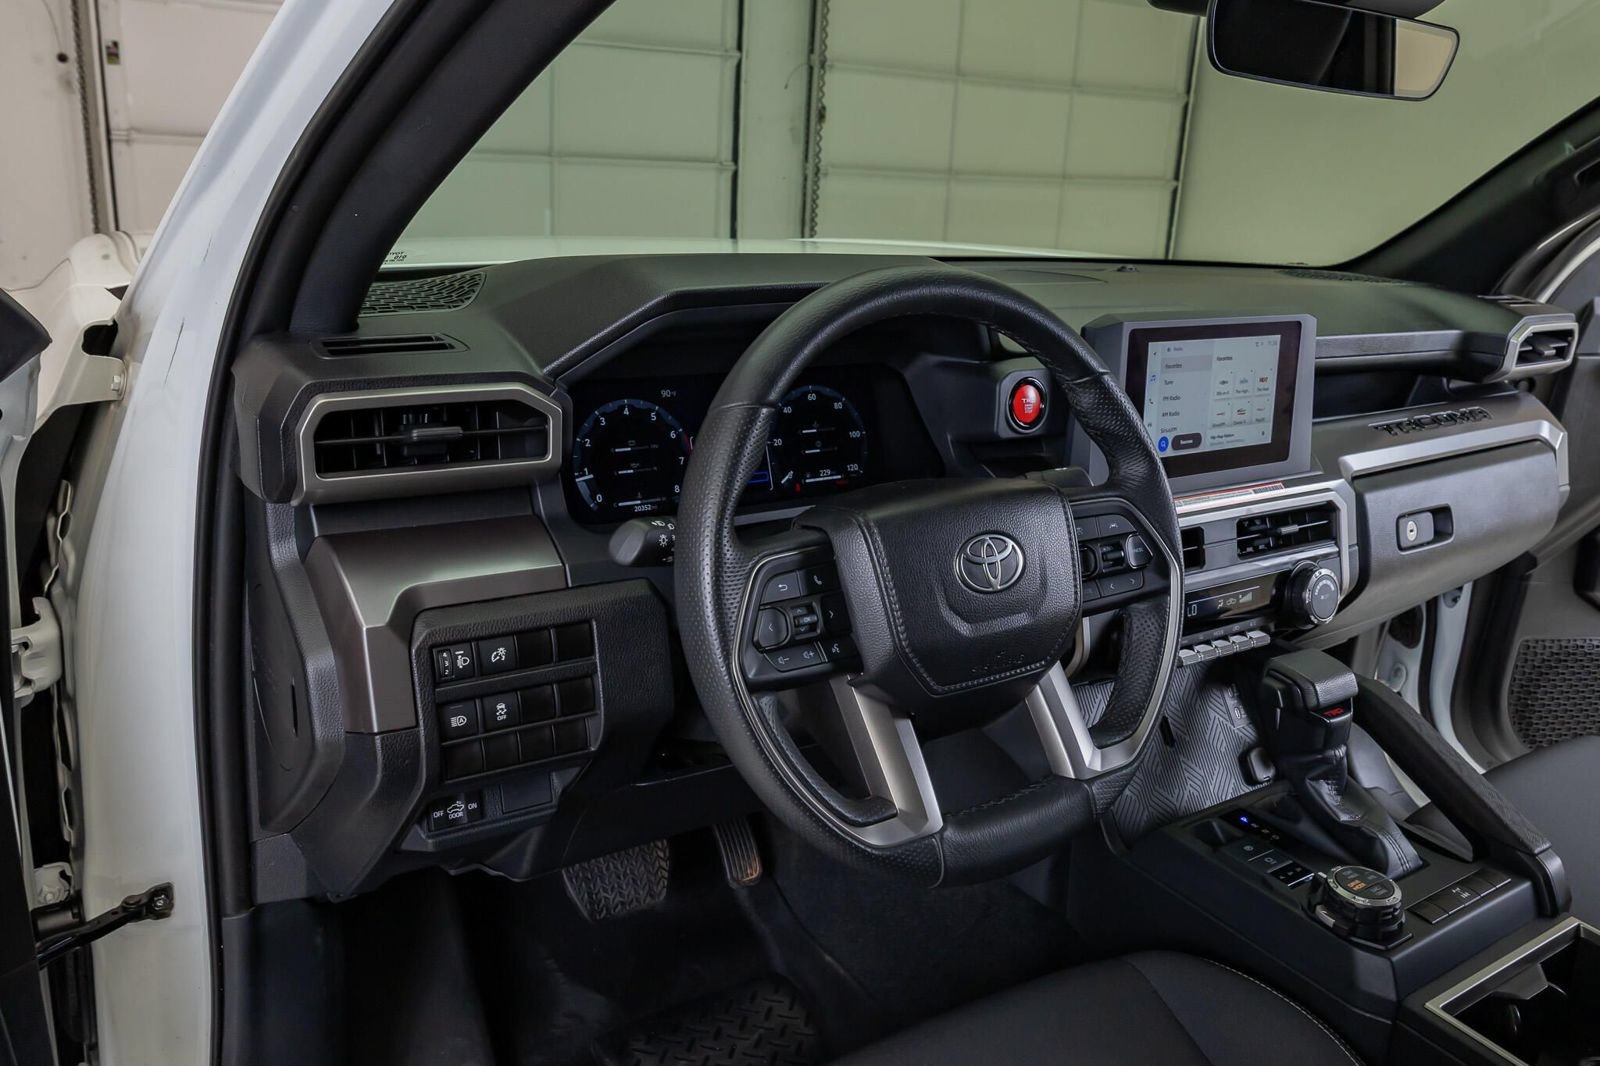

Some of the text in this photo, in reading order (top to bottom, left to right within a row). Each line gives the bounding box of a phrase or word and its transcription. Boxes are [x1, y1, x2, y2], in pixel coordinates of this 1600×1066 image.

[807, 393, 817, 401] 60
[783, 406, 792, 414] 40
[833, 402, 843, 410] 80
[623, 407, 630, 416] 4
[650, 412, 657, 421] 5
[599, 417, 606, 426] 3
[670, 430, 676, 439] 6
[849, 430, 861, 438] 100
[584, 438, 591, 447] 2
[773, 438, 783, 446] 20
[678, 456, 685, 465] 7
[847, 463, 859, 471] 120
[819, 469, 831, 477] 229
[674, 485, 680, 493] 8
[596, 494, 603, 503] 0
[634, 504, 652, 513] 20352
[467, 802, 478, 810] ON
[433, 810, 444, 819] OFF
[448, 811, 464, 820] DOOR
